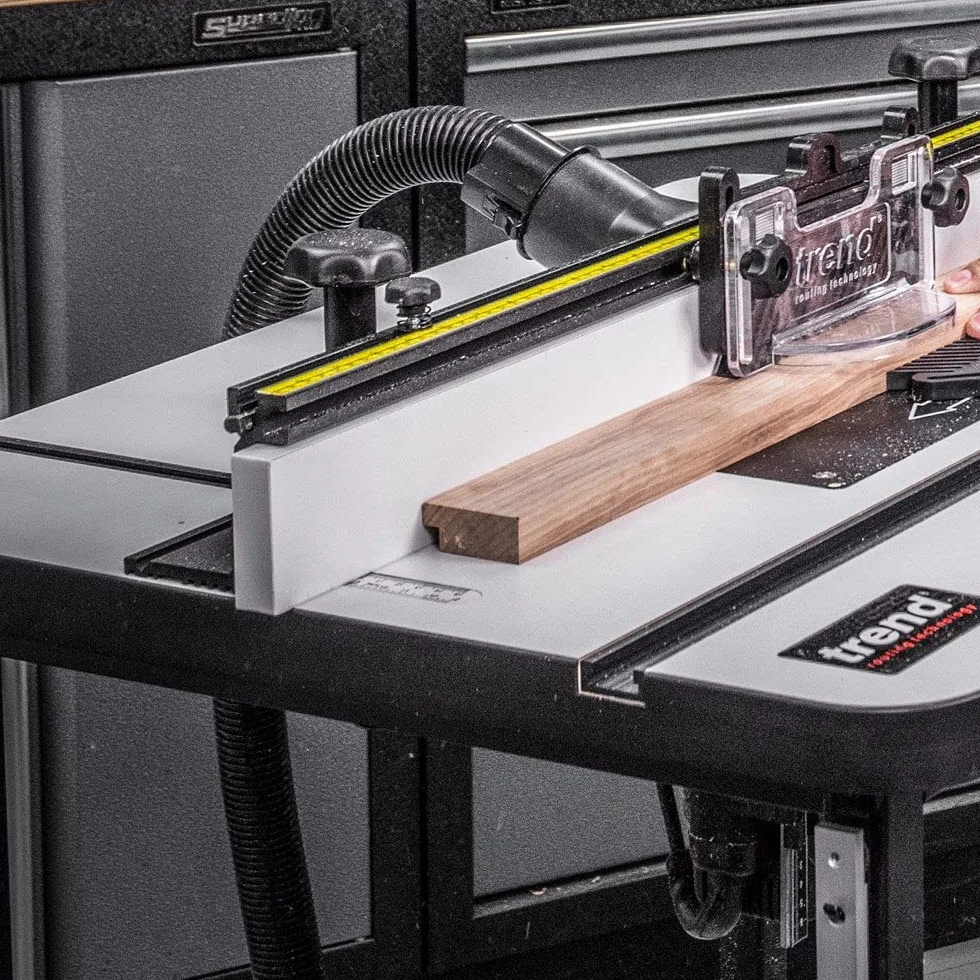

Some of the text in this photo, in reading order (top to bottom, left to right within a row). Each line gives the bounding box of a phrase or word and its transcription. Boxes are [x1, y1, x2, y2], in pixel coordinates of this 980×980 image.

[794, 215, 878, 288] trend
[795, 262, 878, 305] routing technology
[817, 593, 954, 664] trend
